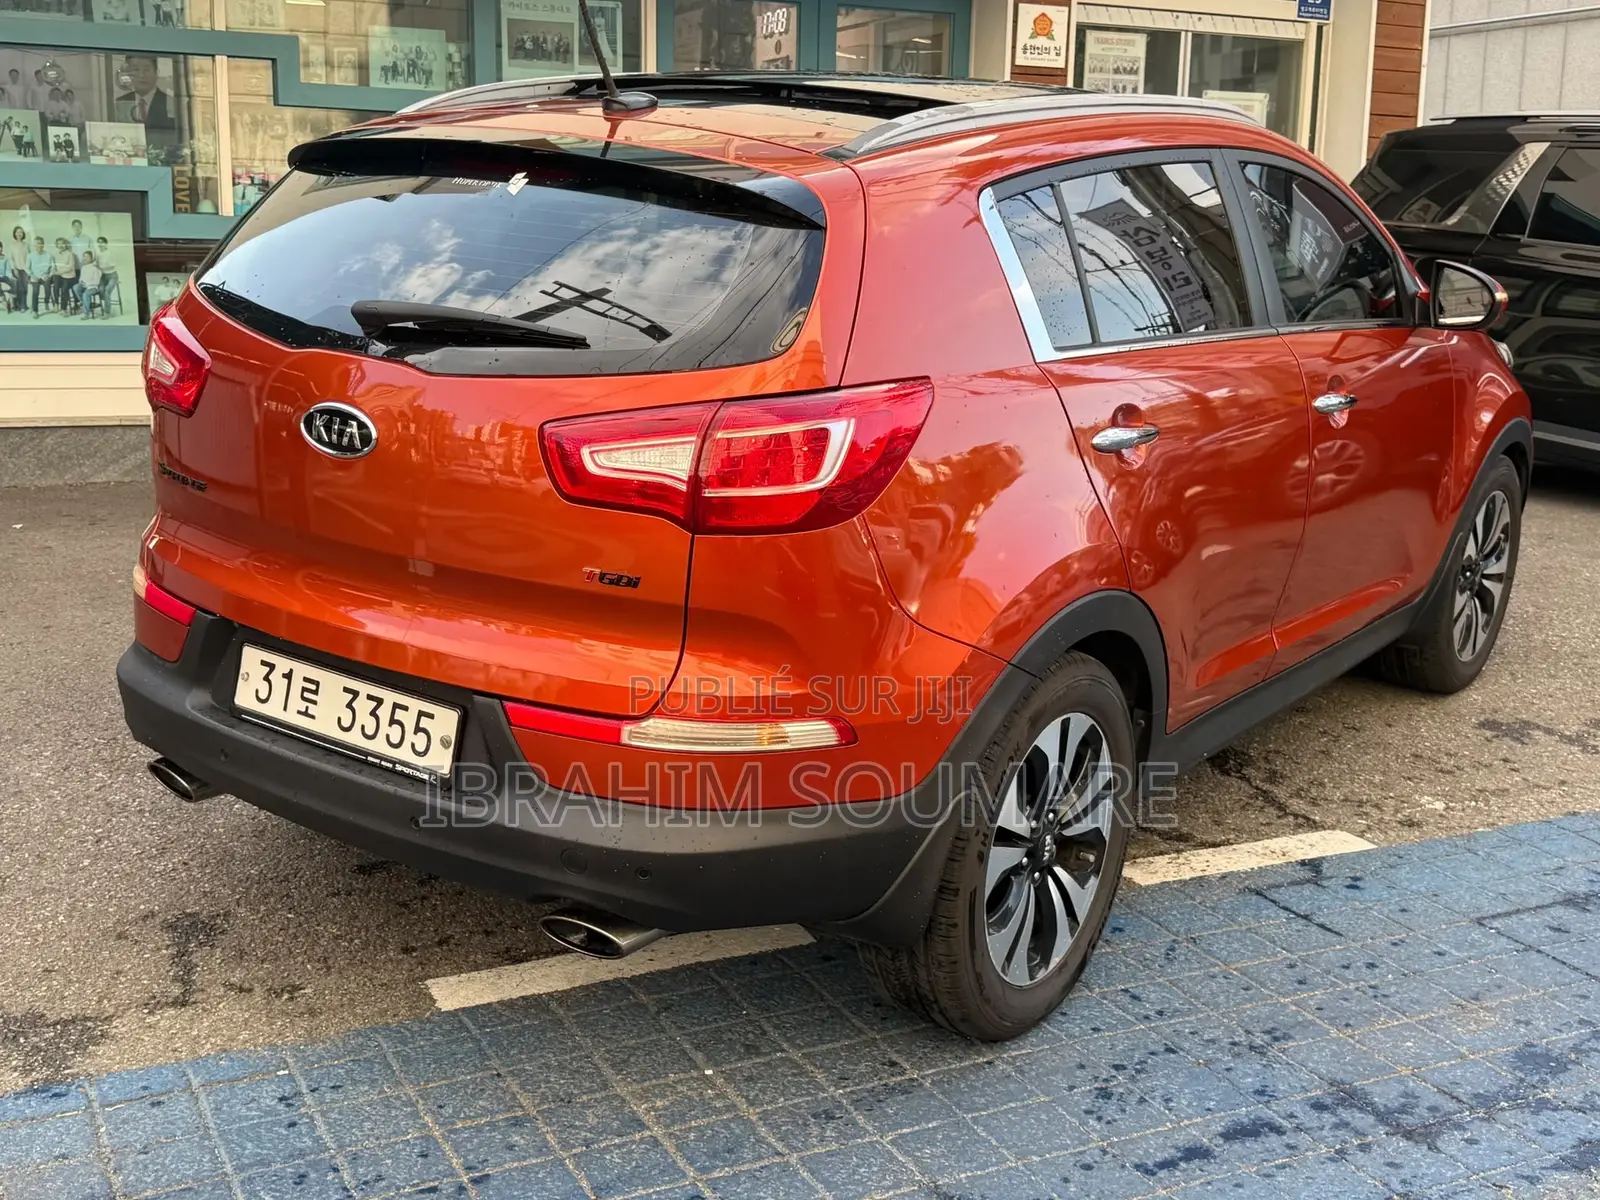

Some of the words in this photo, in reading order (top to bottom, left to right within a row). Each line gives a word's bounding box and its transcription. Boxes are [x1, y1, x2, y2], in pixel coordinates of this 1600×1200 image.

[1053, 45, 1062, 57] 집
[173, 165, 191, 213] LOVE
[312, 411, 362, 450] KIA
[254, 658, 321, 720] 31로
[336, 685, 436, 758] 3355
